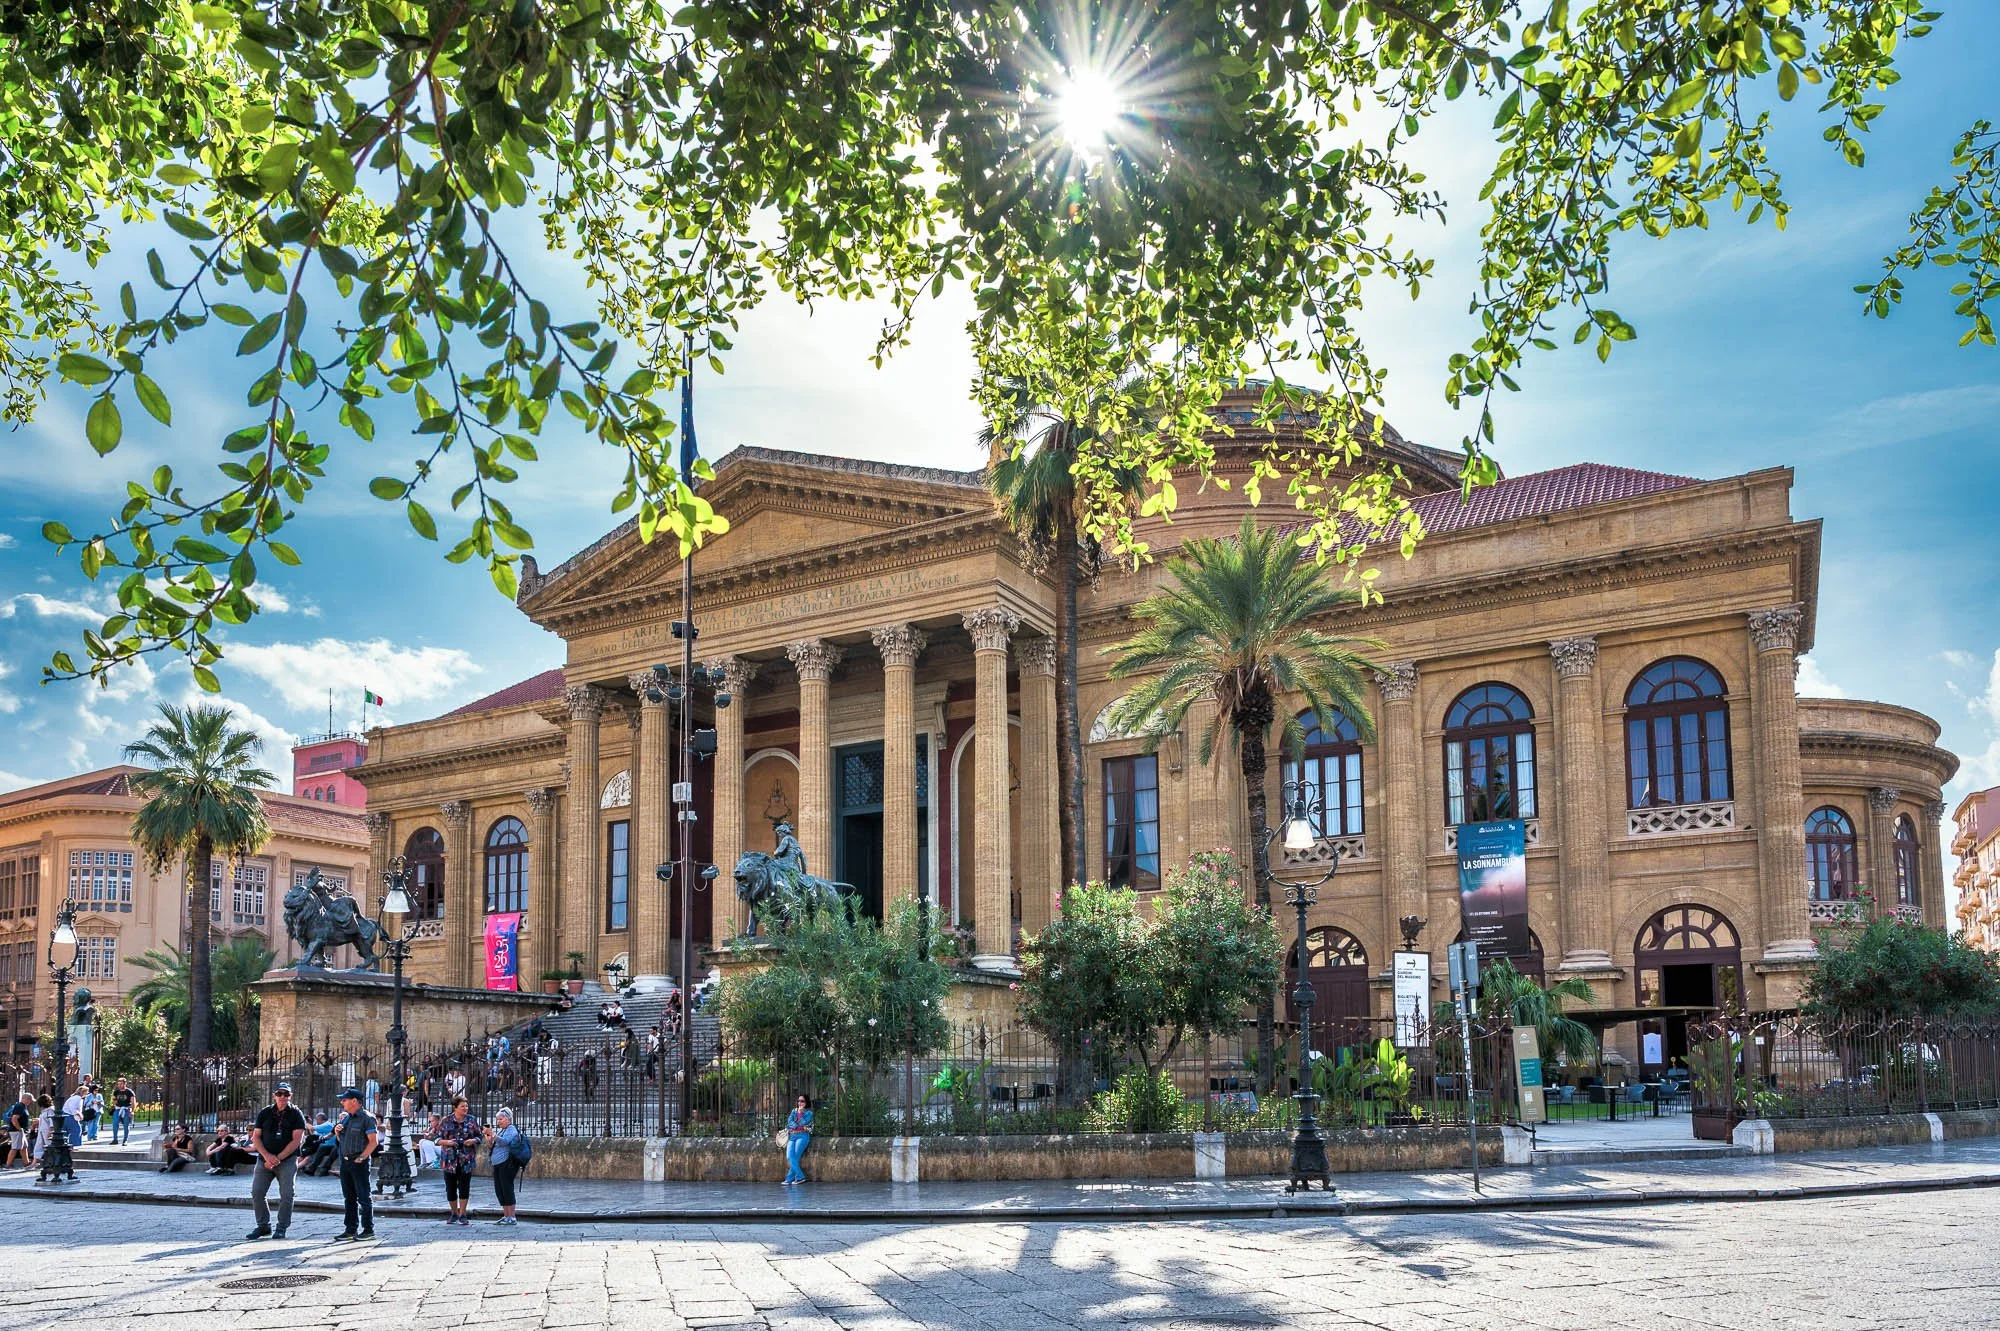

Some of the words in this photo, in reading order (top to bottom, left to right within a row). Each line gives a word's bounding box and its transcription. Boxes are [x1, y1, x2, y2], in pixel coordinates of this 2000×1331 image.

[665, 612, 716, 633] ROVA
[732, 599, 774, 619] POPOLI
[793, 593, 809, 607] NE
[816, 583, 862, 601] RIVELA
[869, 579, 884, 591] LA
[1463, 860, 1472, 870] LA
[1472, 857, 1516, 869] SONNAMBU
[496, 939, 509, 953] 25
[494, 951, 508, 968] 26
